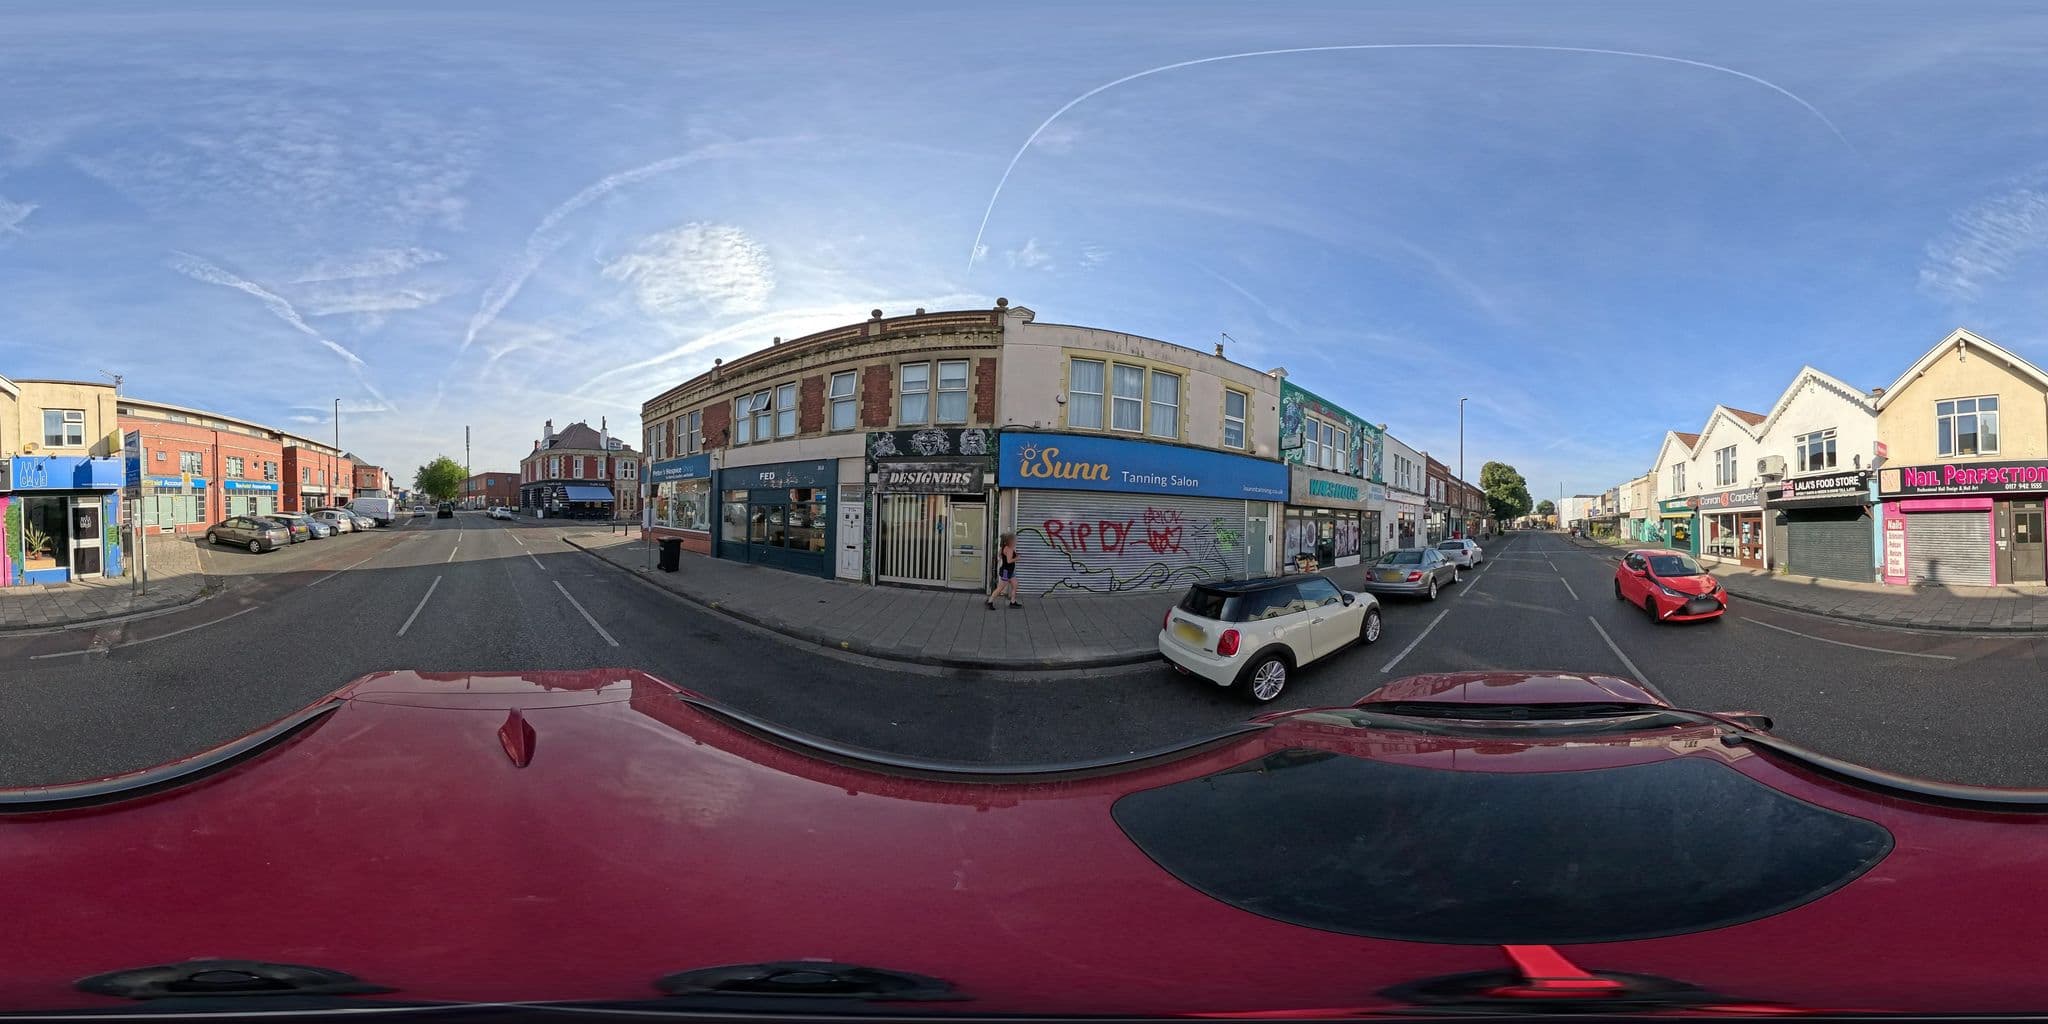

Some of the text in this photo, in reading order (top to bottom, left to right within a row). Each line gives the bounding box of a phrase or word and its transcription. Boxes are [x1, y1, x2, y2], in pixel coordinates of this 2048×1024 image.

[1019, 447, 1111, 481] iSunn
[760, 472, 775, 480] FED
[889, 472, 972, 484] DESIGNERS
[1122, 471, 1199, 488] Tanning Salon
[1795, 475, 1859, 491] LALA'S FOOD STORE
[1729, 491, 1759, 504] Carpets
[1887, 519, 1903, 530] Nails
